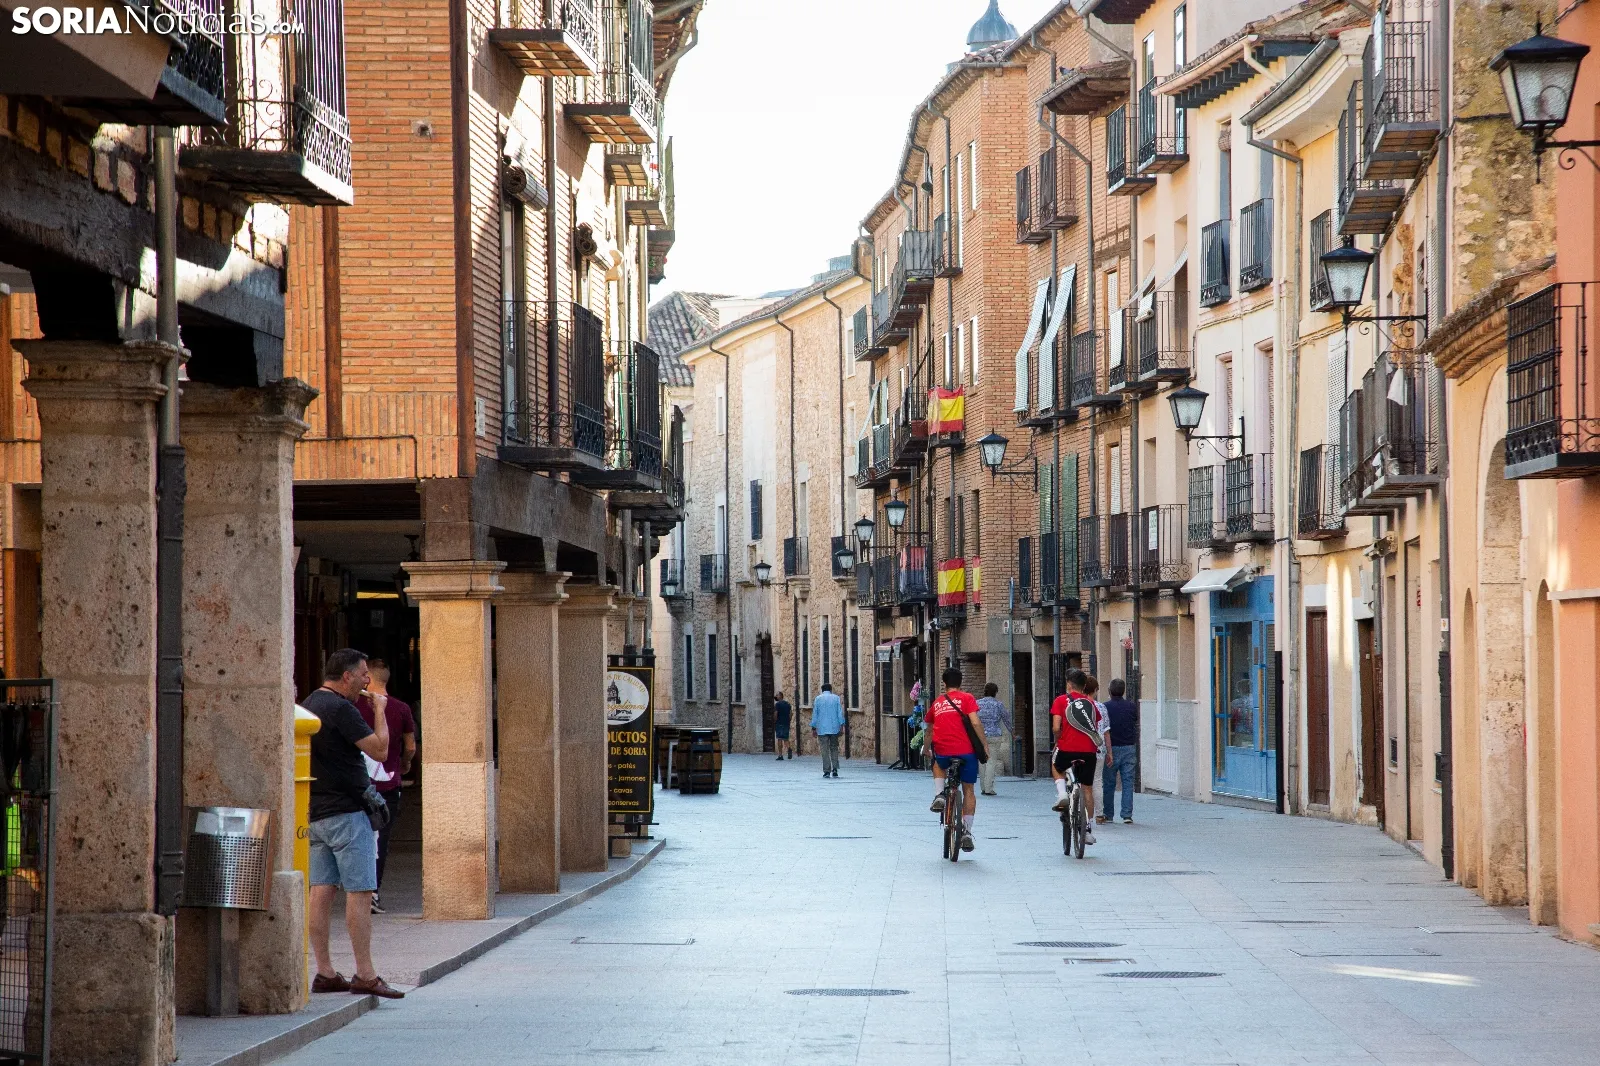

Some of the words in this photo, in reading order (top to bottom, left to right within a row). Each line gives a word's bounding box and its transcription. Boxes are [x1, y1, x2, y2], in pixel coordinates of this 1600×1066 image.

[611, 746, 622, 756] DE
[623, 746, 647, 756] SORIA
[618, 774, 646, 782] jamones
